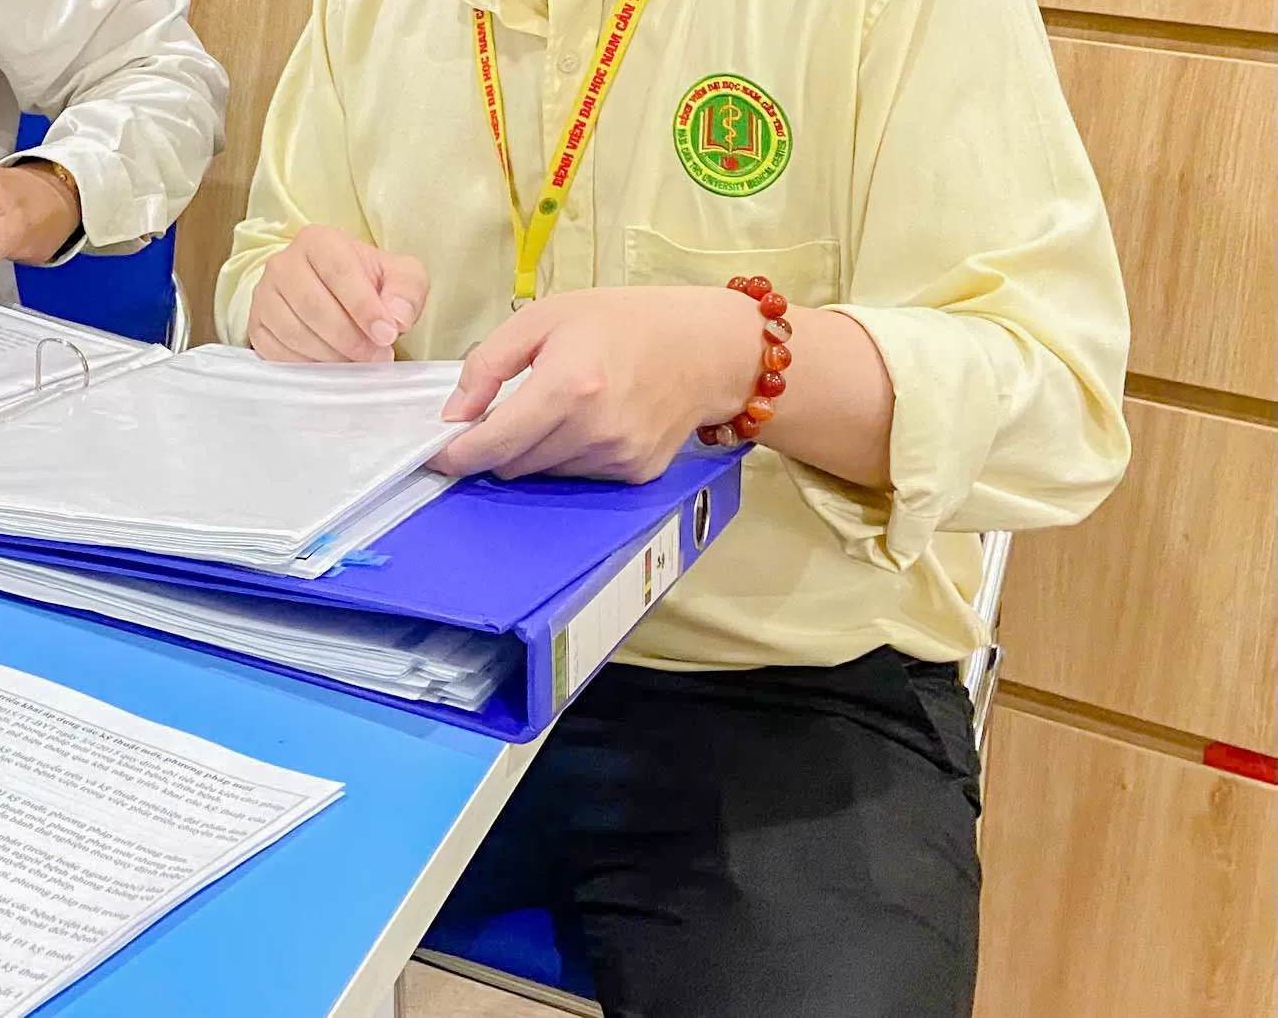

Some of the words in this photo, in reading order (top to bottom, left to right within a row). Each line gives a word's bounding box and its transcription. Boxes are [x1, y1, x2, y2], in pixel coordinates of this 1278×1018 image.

[552, 151, 575, 188] BỆNH
[566, 118, 587, 155] VIỆN
[579, 94, 597, 119] ĐẠI
[588, 67, 608, 95] HỌC
[600, 33, 623, 67] NAM
[614, 4, 636, 32] CẦN
